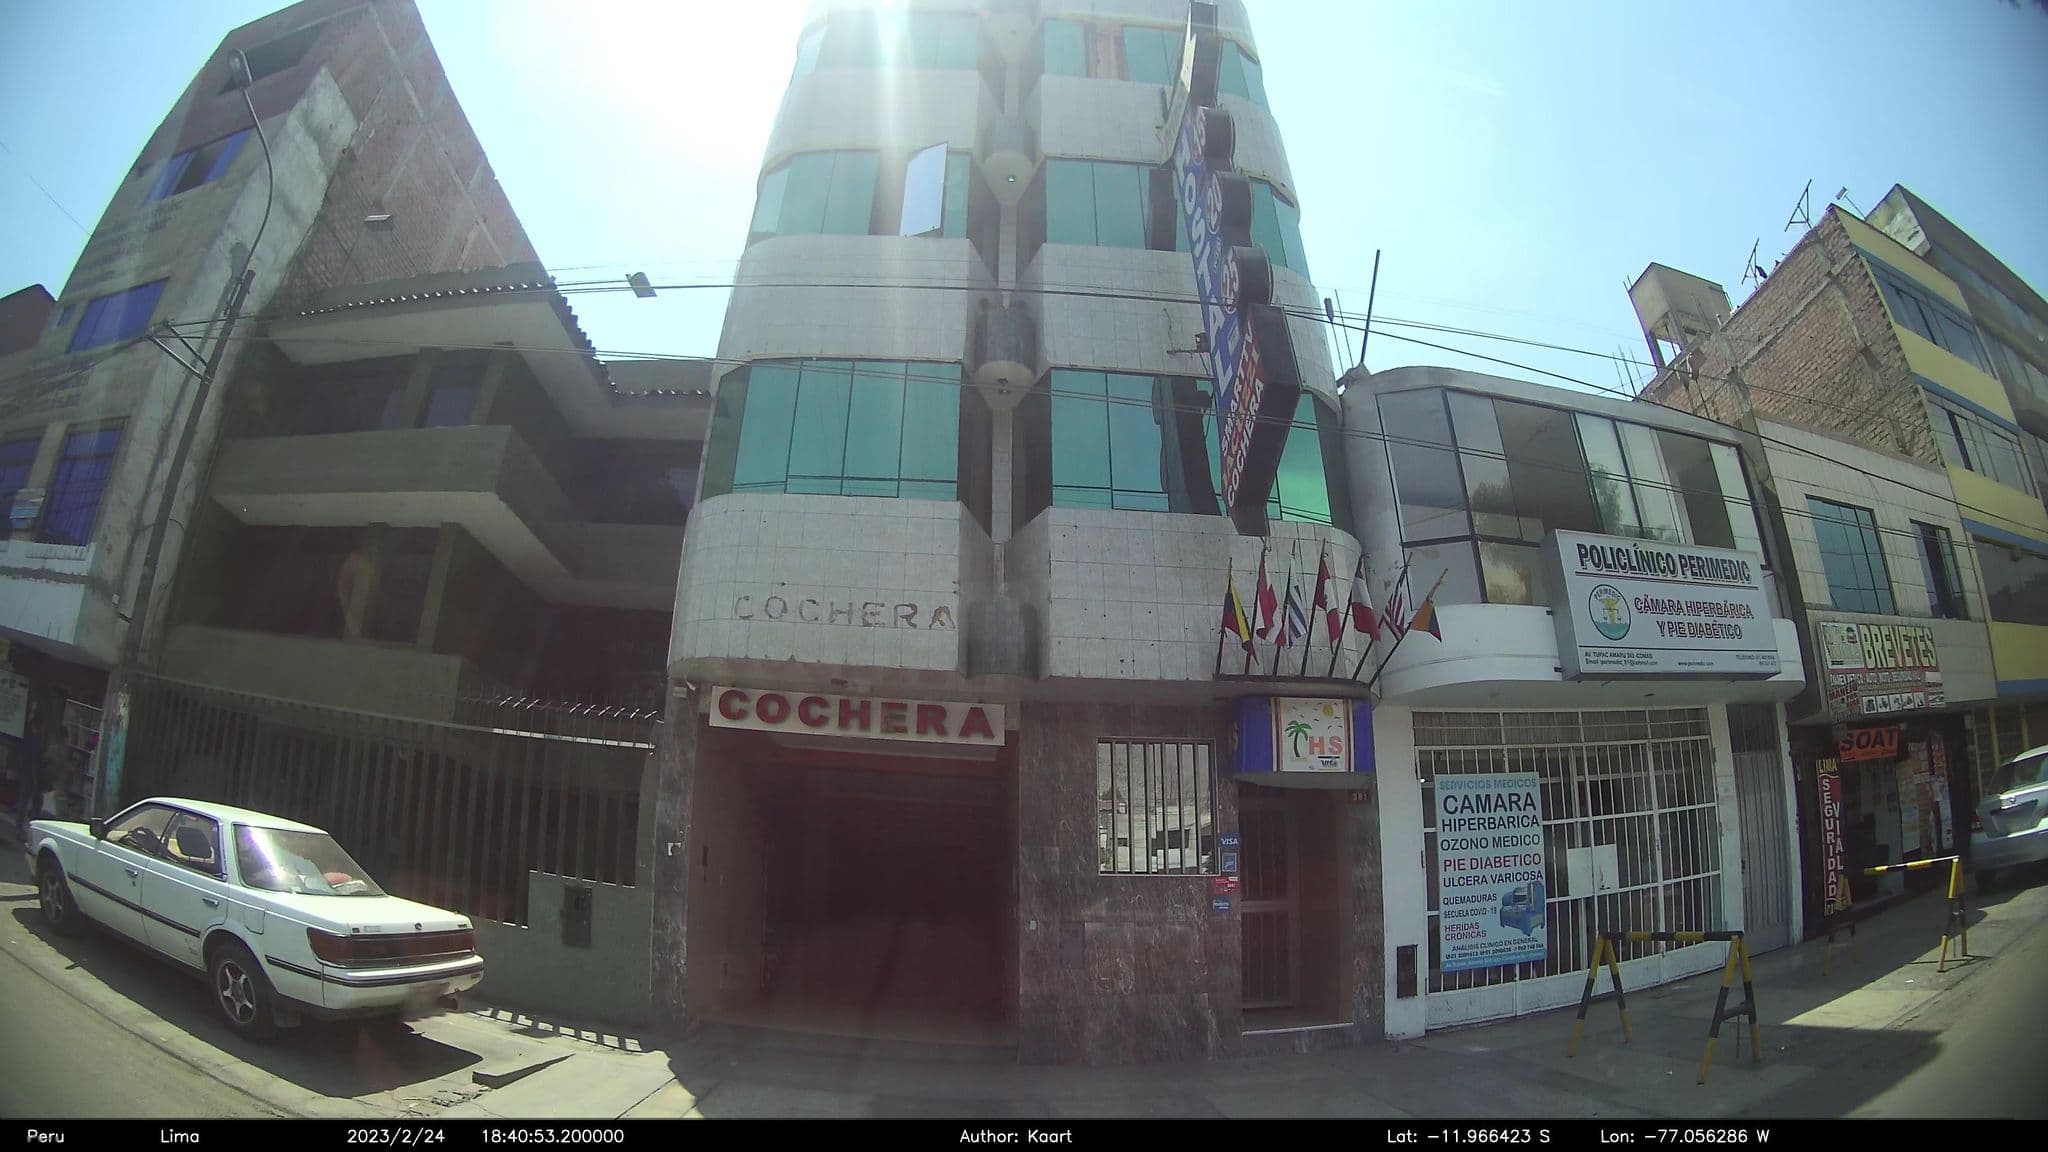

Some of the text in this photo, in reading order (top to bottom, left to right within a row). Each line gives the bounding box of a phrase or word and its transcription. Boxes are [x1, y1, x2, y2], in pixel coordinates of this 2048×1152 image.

[1227, 376, 1265, 508] COCHERA
[1576, 543, 1752, 584] POLICLÍNICO PERIMEDIC
[734, 595, 956, 630] COCHERA
[1634, 594, 1754, 619] CÁMARA HIPERBÁRICA
[1656, 620, 1743, 639] Y PIE DIABÉTICO
[1859, 623, 1938, 670] BREVETES
[718, 689, 995, 739] COCHERA
[1840, 729, 1897, 751] SOAT
[1439, 778, 1537, 791] SERVICIOS MEDICOS
[1443, 792, 1537, 815] CAMARA
[1442, 814, 1540, 832] HIPERBARICA
[1220, 837, 1238, 846] VISA
[1440, 834, 1540, 851] OZONO MEDICO
[1822, 778, 1837, 897] SEGURIDAD
[1833, 802, 1844, 871] VIAL
[1443, 853, 1542, 872] PIE DIABETICO
[1443, 870, 1544, 888] ULCERA VARICOSA
[1442, 893, 1498, 906] QUEMADURAS
[1444, 909, 1469, 919] SECUELA
[1444, 921, 1480, 933] HERIDAS
